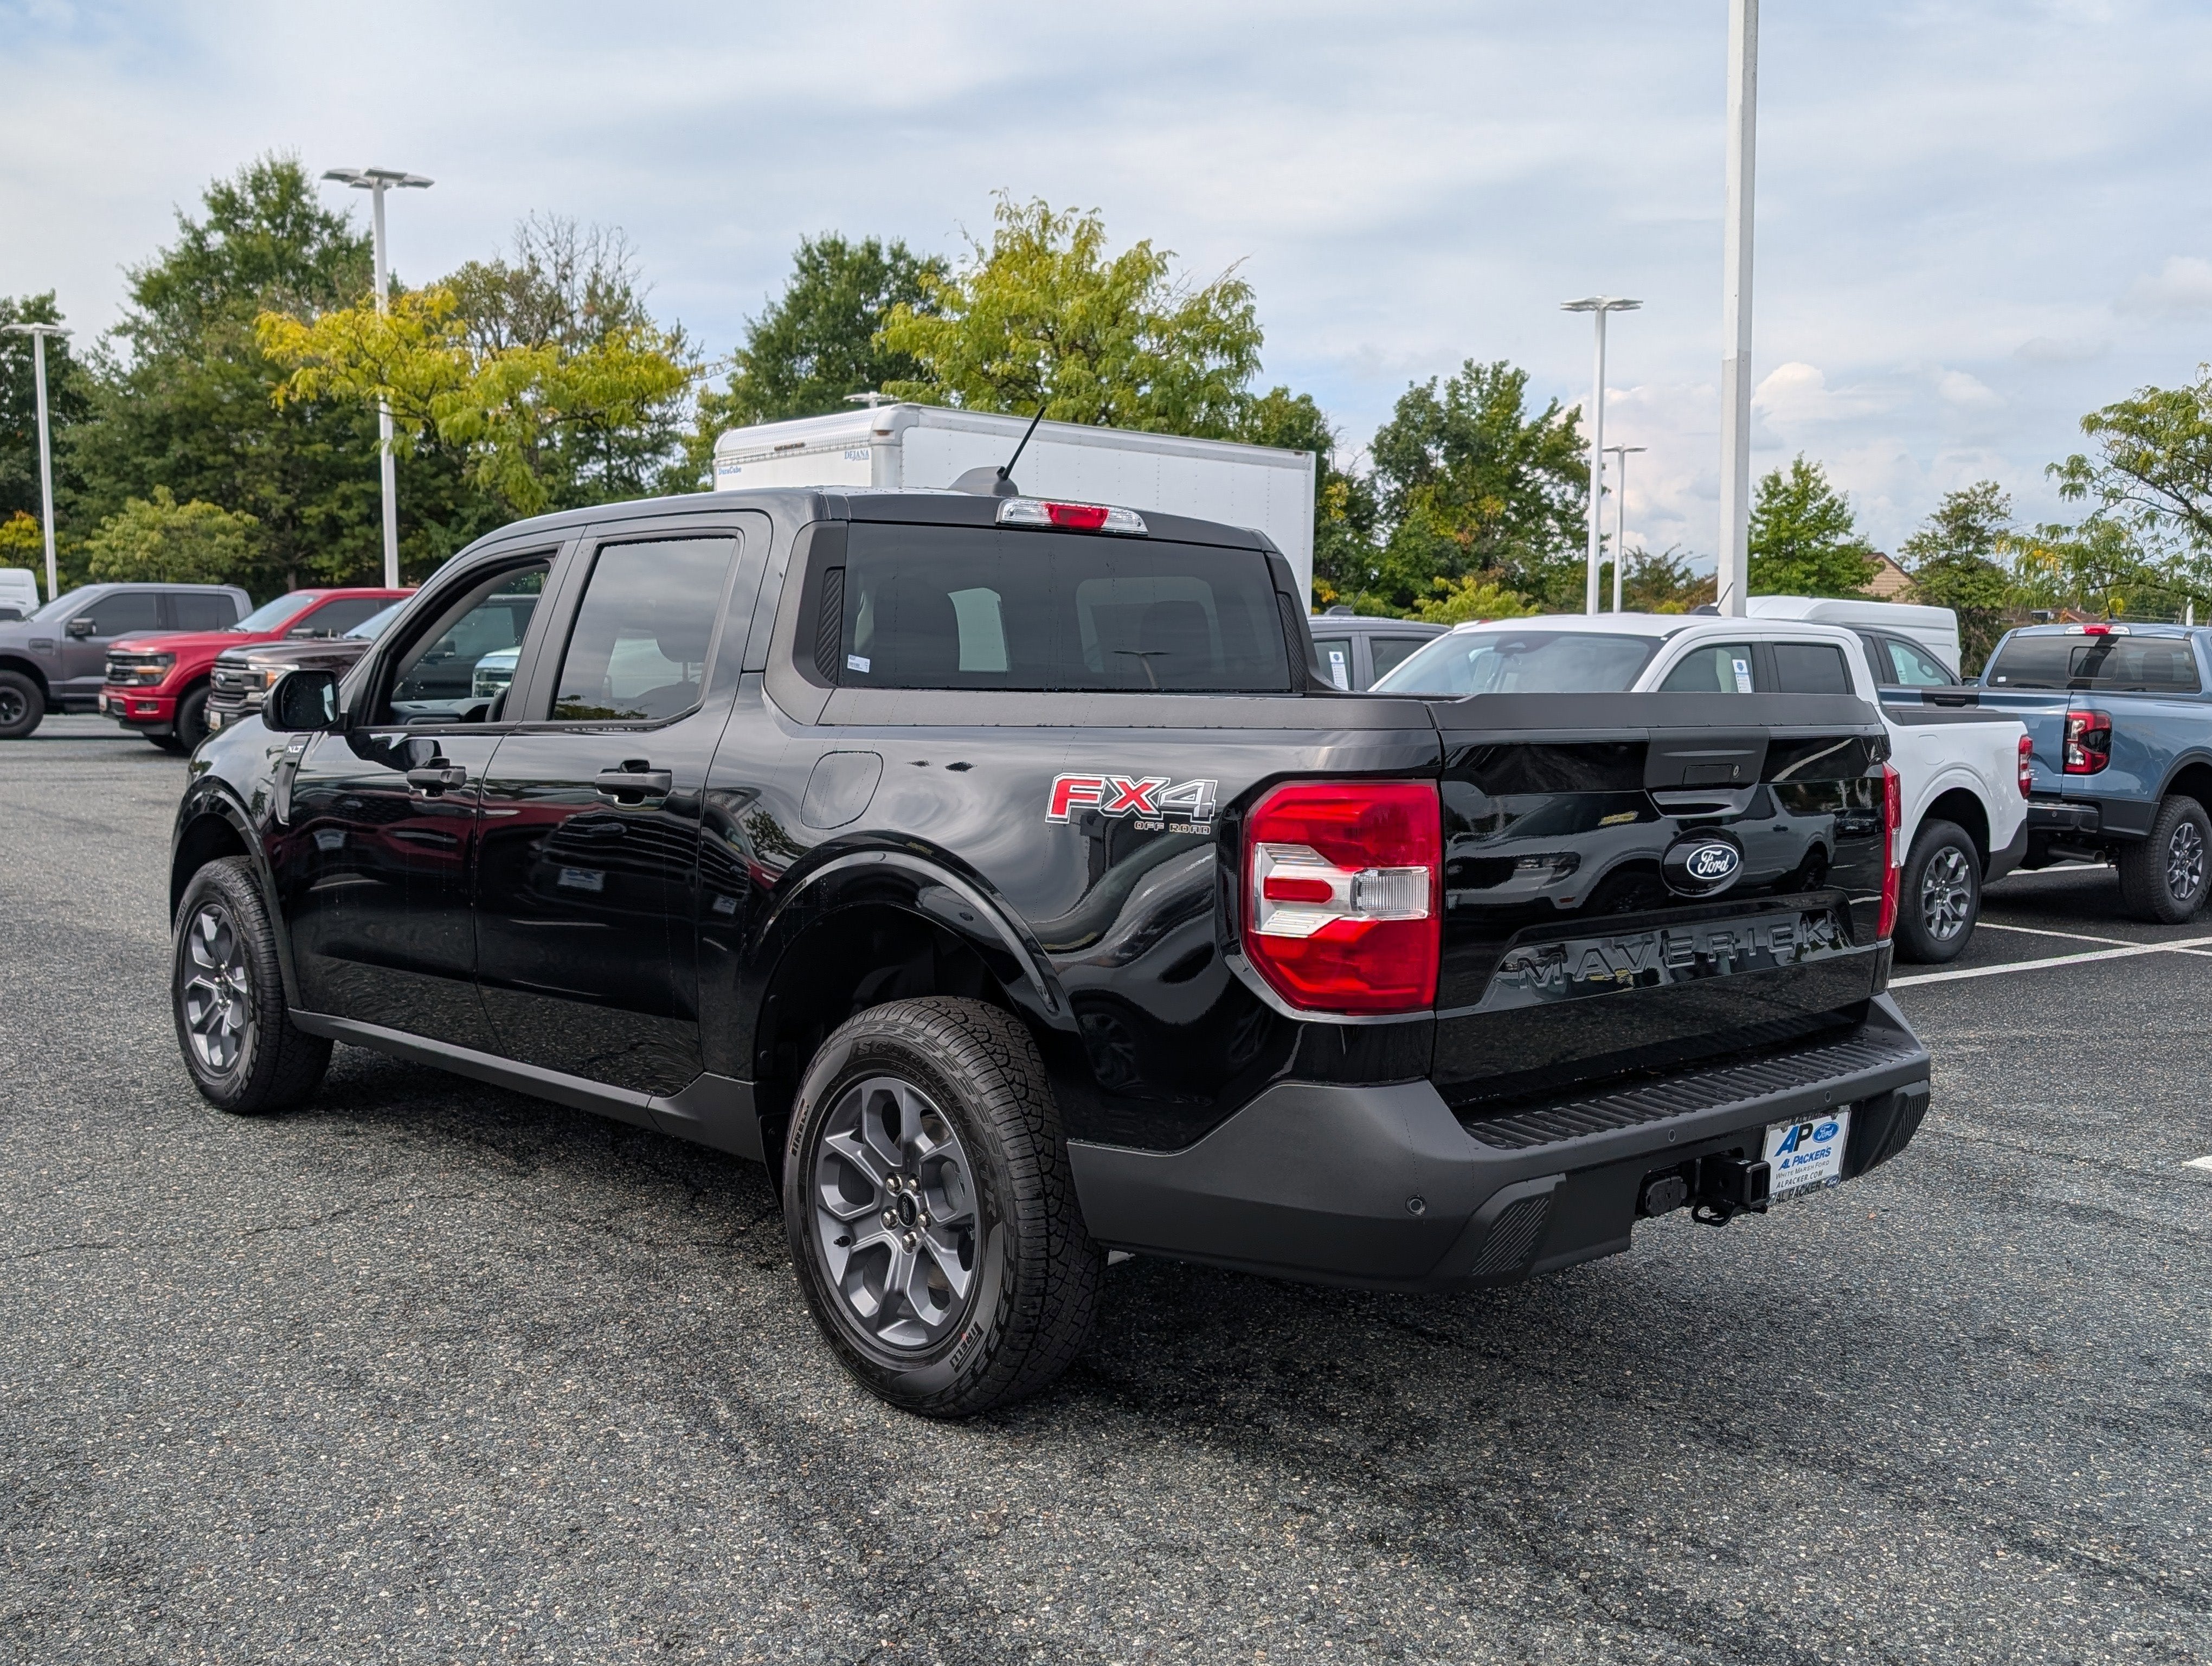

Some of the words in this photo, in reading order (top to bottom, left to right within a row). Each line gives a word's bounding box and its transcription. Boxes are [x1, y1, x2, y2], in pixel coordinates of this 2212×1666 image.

[1045, 773, 1218, 824] FX4
[1134, 821, 1164, 831] OFF
[1169, 823, 1211, 835] ROAD
[1697, 850, 1729, 874] Ford
[1519, 918, 1832, 989] MAVERICK
[1774, 1123, 1814, 1157] AP
[1817, 1125, 1835, 1139] Ford
[1778, 1158, 1791, 1171] AL
[1788, 1181, 1822, 1200] PACKER
[949, 1321, 984, 1373] PIRELLI
